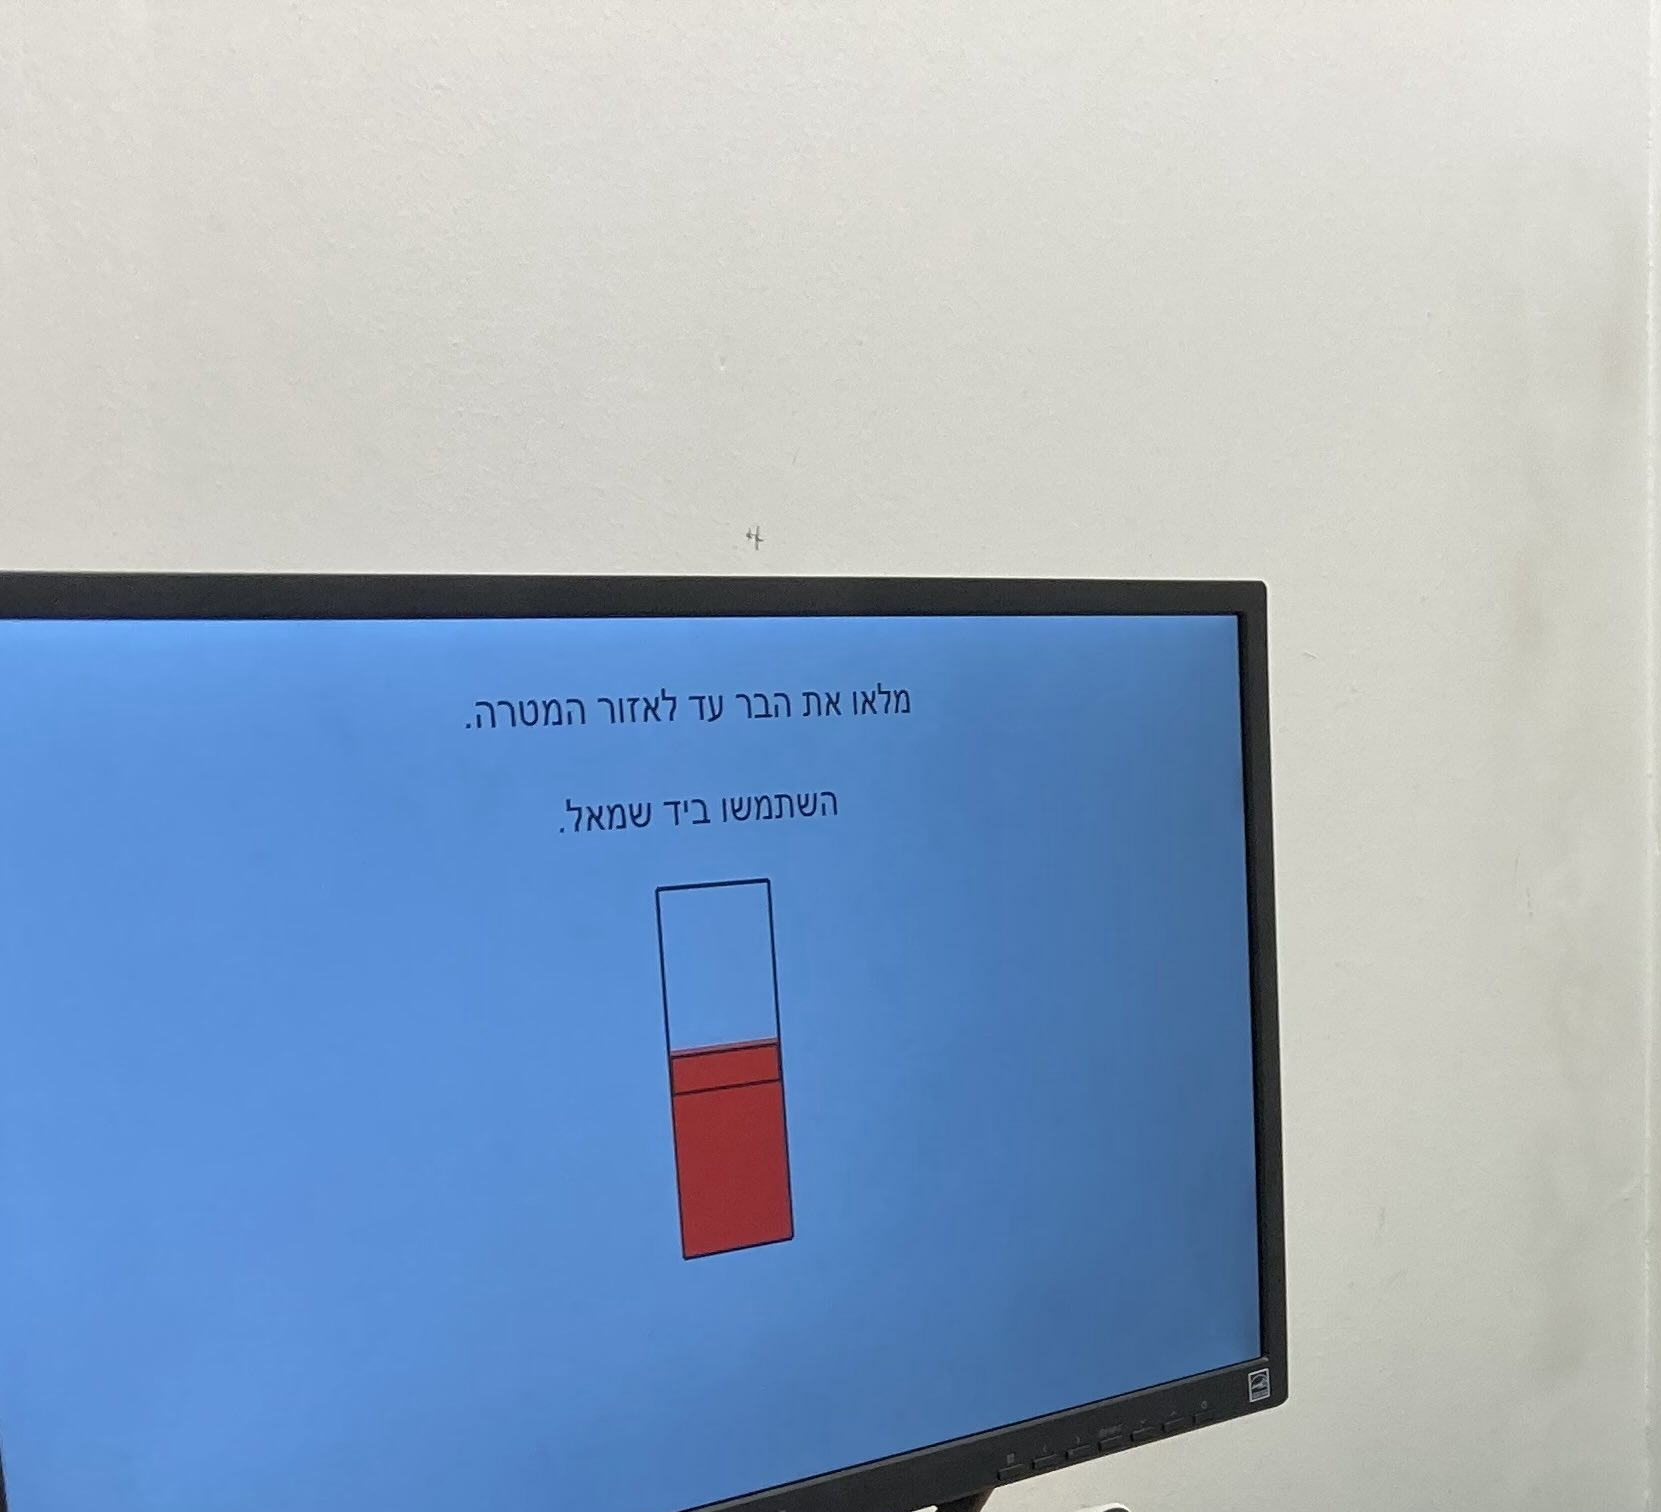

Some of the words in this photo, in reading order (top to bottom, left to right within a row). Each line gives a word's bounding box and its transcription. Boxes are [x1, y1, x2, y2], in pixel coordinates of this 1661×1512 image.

[465, 699, 587, 729] המטרה.
[597, 688, 677, 725] לאזור
[688, 694, 724, 723] עד
[736, 692, 792, 719] הבר
[802, 690, 842, 717] את
[853, 683, 911, 716] מלאו
[560, 799, 652, 834] שמאל.
[664, 798, 711, 826] ביד
[721, 791, 838, 823] השתמשו
